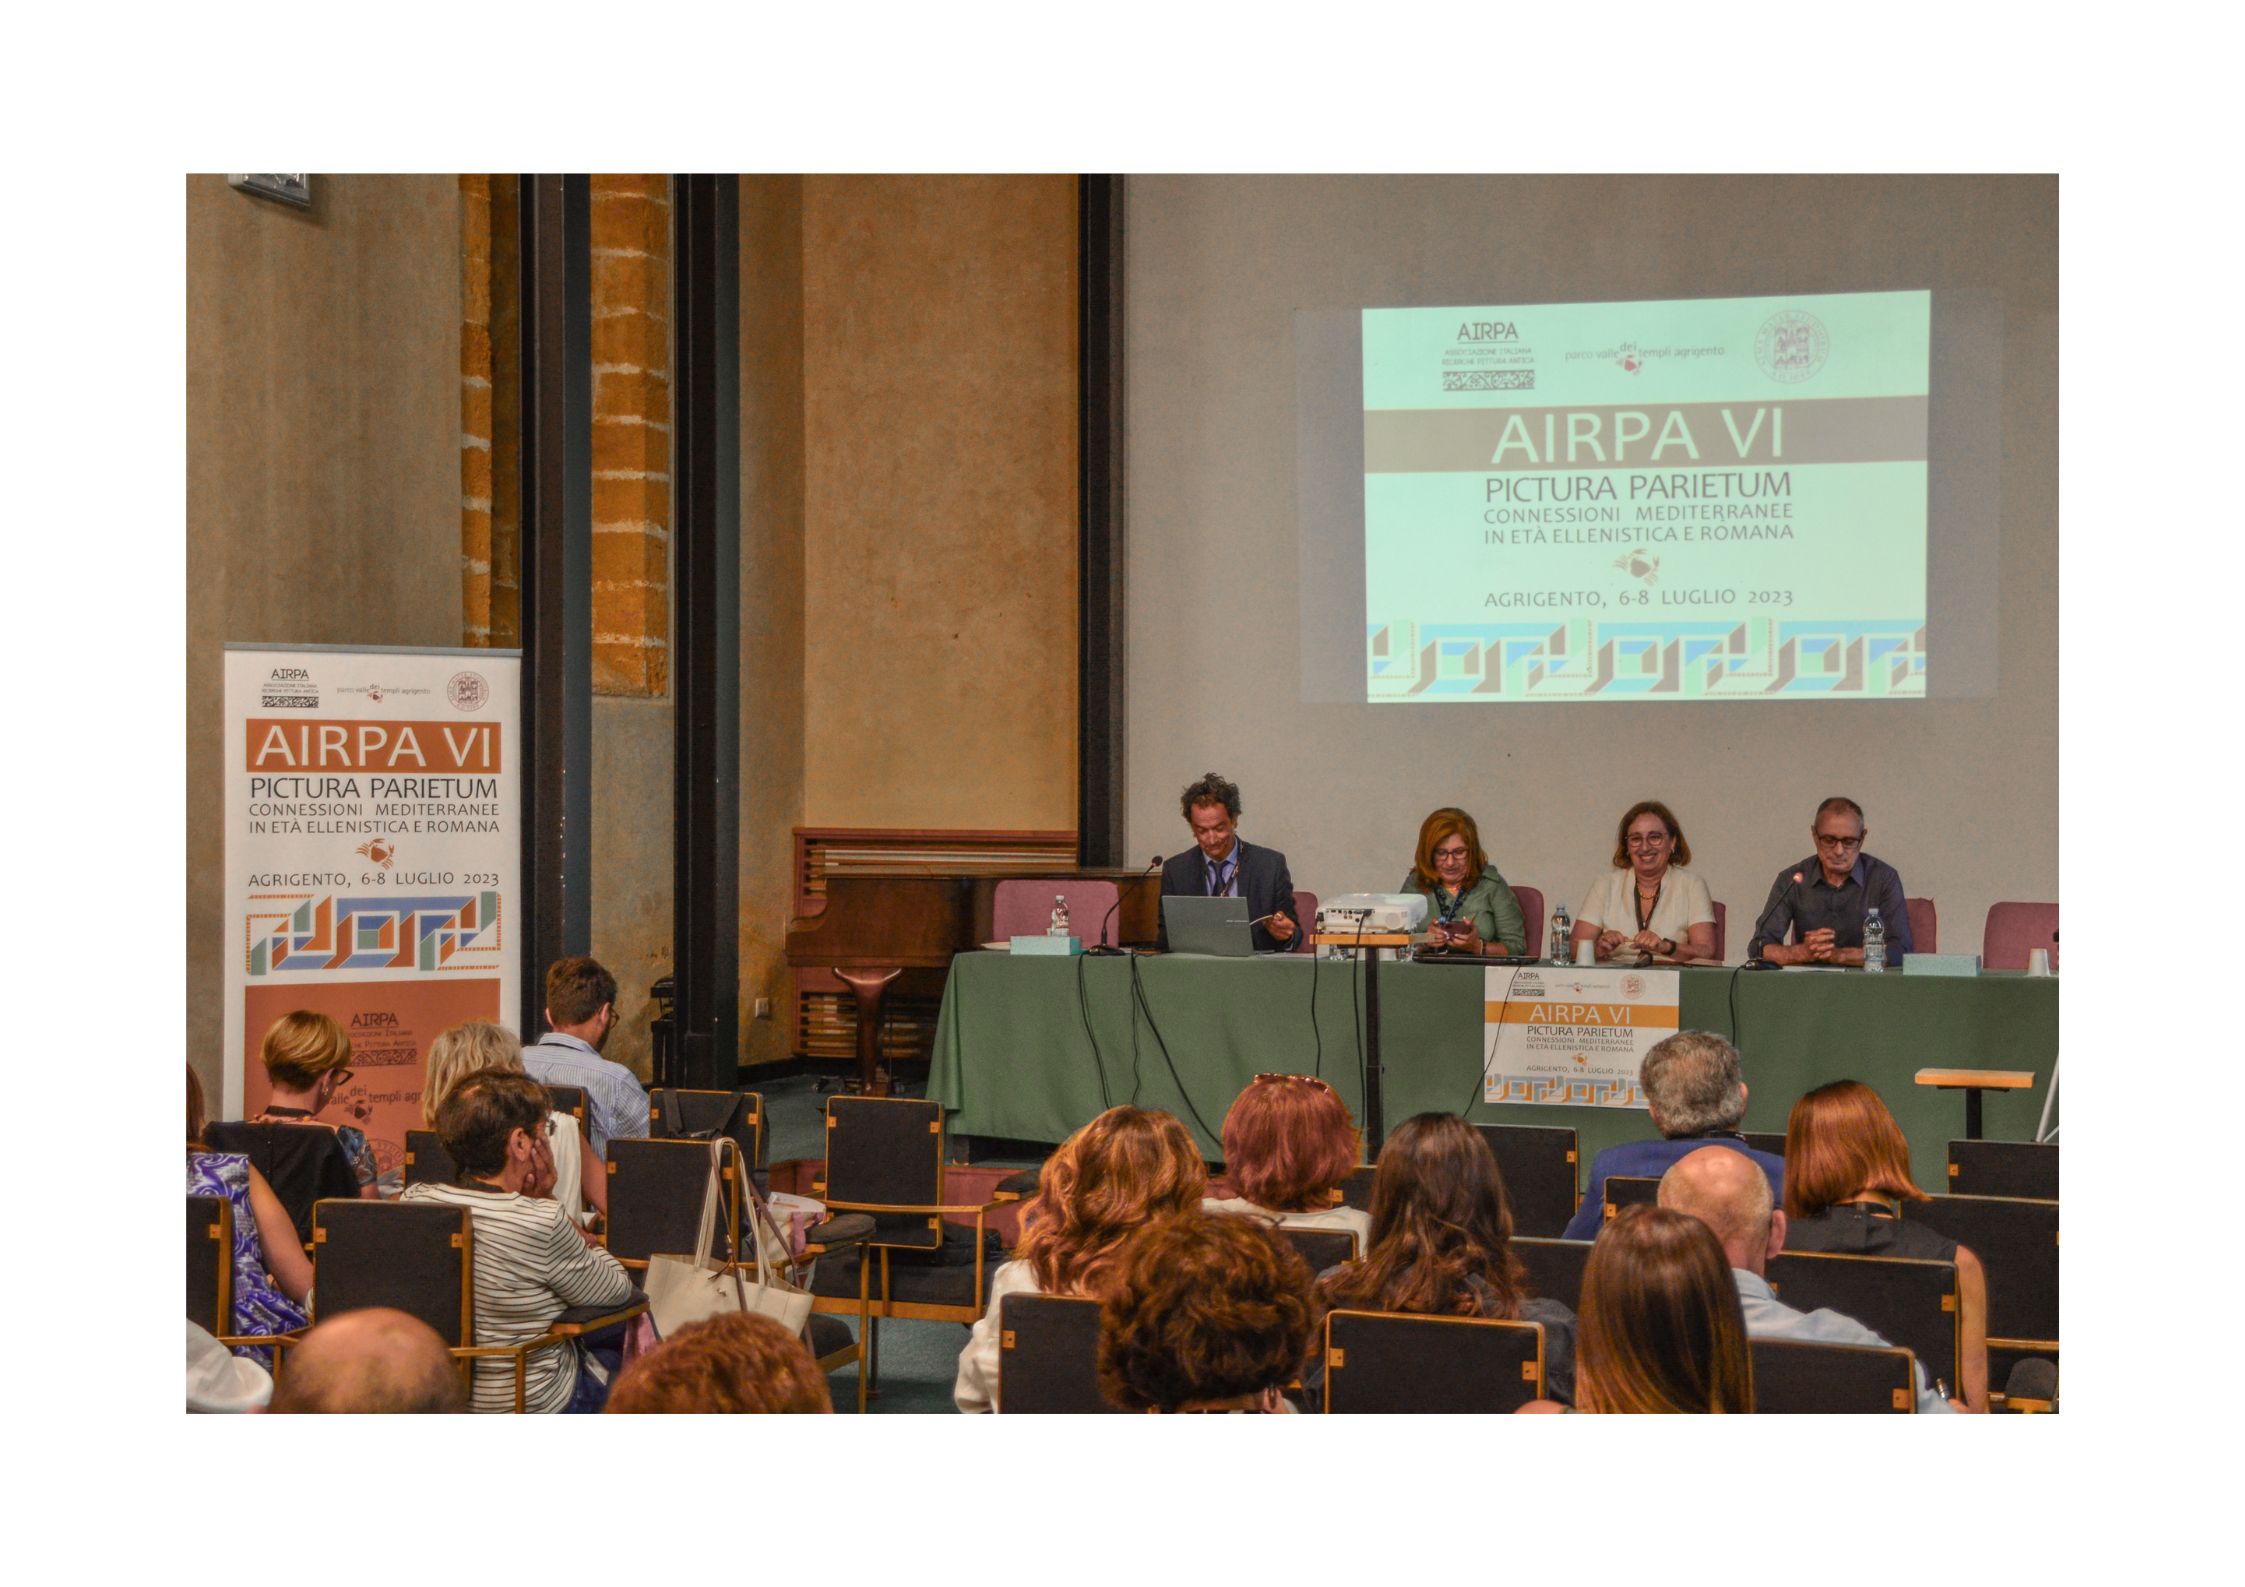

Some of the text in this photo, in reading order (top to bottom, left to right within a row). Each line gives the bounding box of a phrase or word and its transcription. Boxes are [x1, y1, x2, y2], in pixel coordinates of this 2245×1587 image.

[1457, 321, 1519, 341] AIRPA
[1565, 341, 1725, 361] parco valle dei templi agrigento
[1491, 407, 1782, 464] AIRPA VI
[1486, 471, 1792, 503] PICTURA PARIETUM
[1484, 503, 1793, 524] CONNESSIONI MEDITERRANEE
[1484, 524, 1794, 544] IN ETÀ ELLENISTICA E ROMANA
[1484, 589, 1793, 608] AGRIGENTO, 6-8 LUGLIO 2023
[271, 668, 309, 680] AIRPA
[255, 725, 490, 767] AIRPA VI
[251, 778, 497, 798] PICTURA PARIETUM
[249, 803, 499, 816] CONNESSIONI MEDITERRANEE
[250, 818, 500, 833] IN ETÀ ELLENISTICA E ROMANA
[248, 872, 499, 888] AGRIGENTO, 6-8 LUGLIO 2023
[351, 1012, 399, 1027] AIRPA
[1529, 1004, 1631, 1025] AIRPA VI
[1527, 1026, 1633, 1038] PICTURA PARIETUM
[1550, 1044, 1594, 1053] ELLENISTICA
[1579, 1038, 1634, 1046] MEDITERRANEE
[1526, 1065, 1570, 1073] AGRIGENTO,
[1588, 1067, 1614, 1075] LUGLIO
[331, 1094, 349, 1105] alle
[350, 1084, 367, 1097] dei
[369, 1090, 400, 1105] templi
